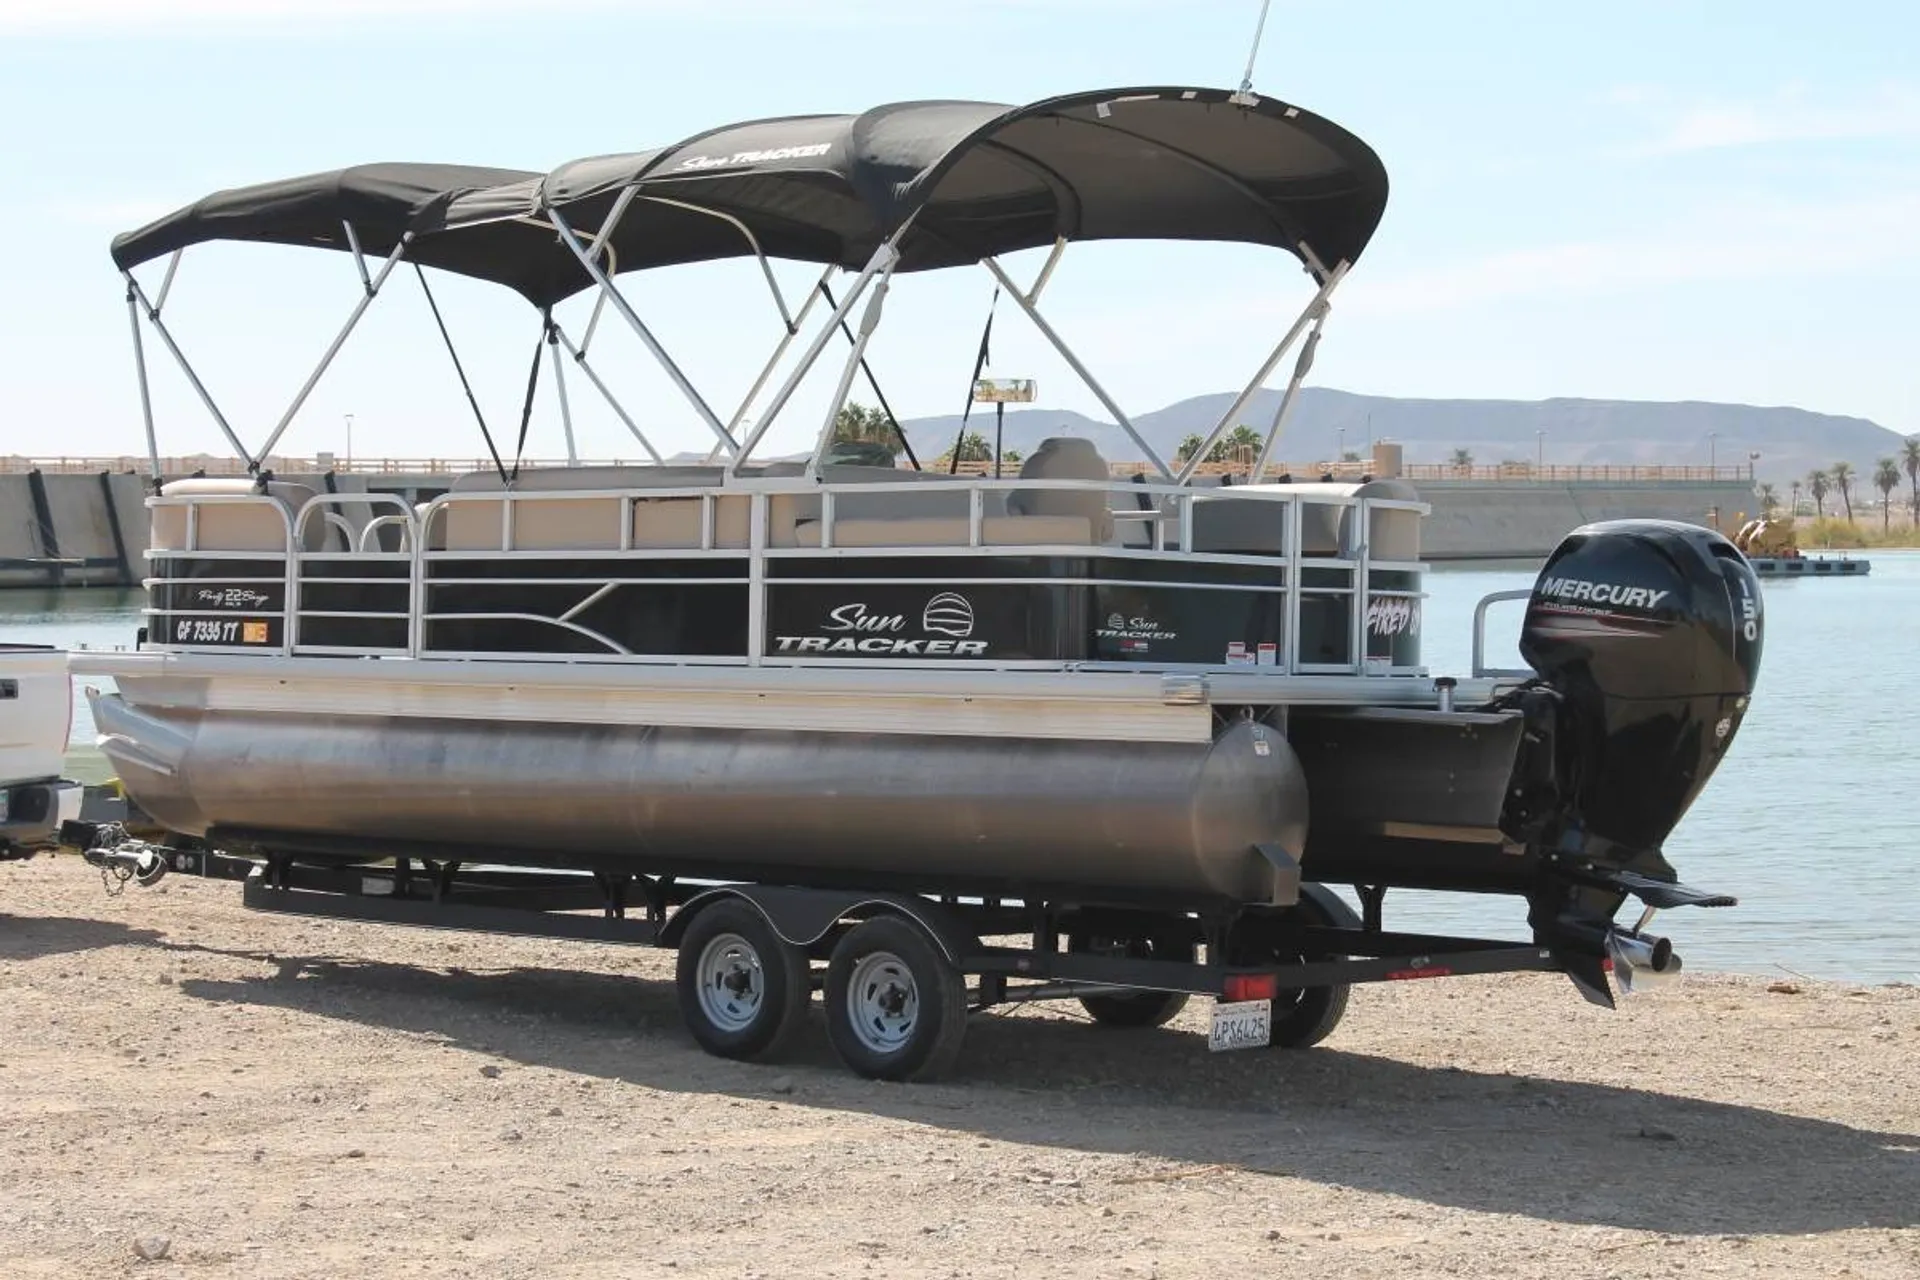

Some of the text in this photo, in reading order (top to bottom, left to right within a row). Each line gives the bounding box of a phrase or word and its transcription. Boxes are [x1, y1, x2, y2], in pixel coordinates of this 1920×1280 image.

[730, 143, 832, 164] TRACKER
[224, 588, 241, 602] 22
[1541, 577, 1669, 609] MERCURY
[820, 603, 908, 632] Sun
[1739, 577, 1757, 642] 150
[1095, 629, 1177, 640] TRACKER
[775, 636, 989, 655] TRACKER
